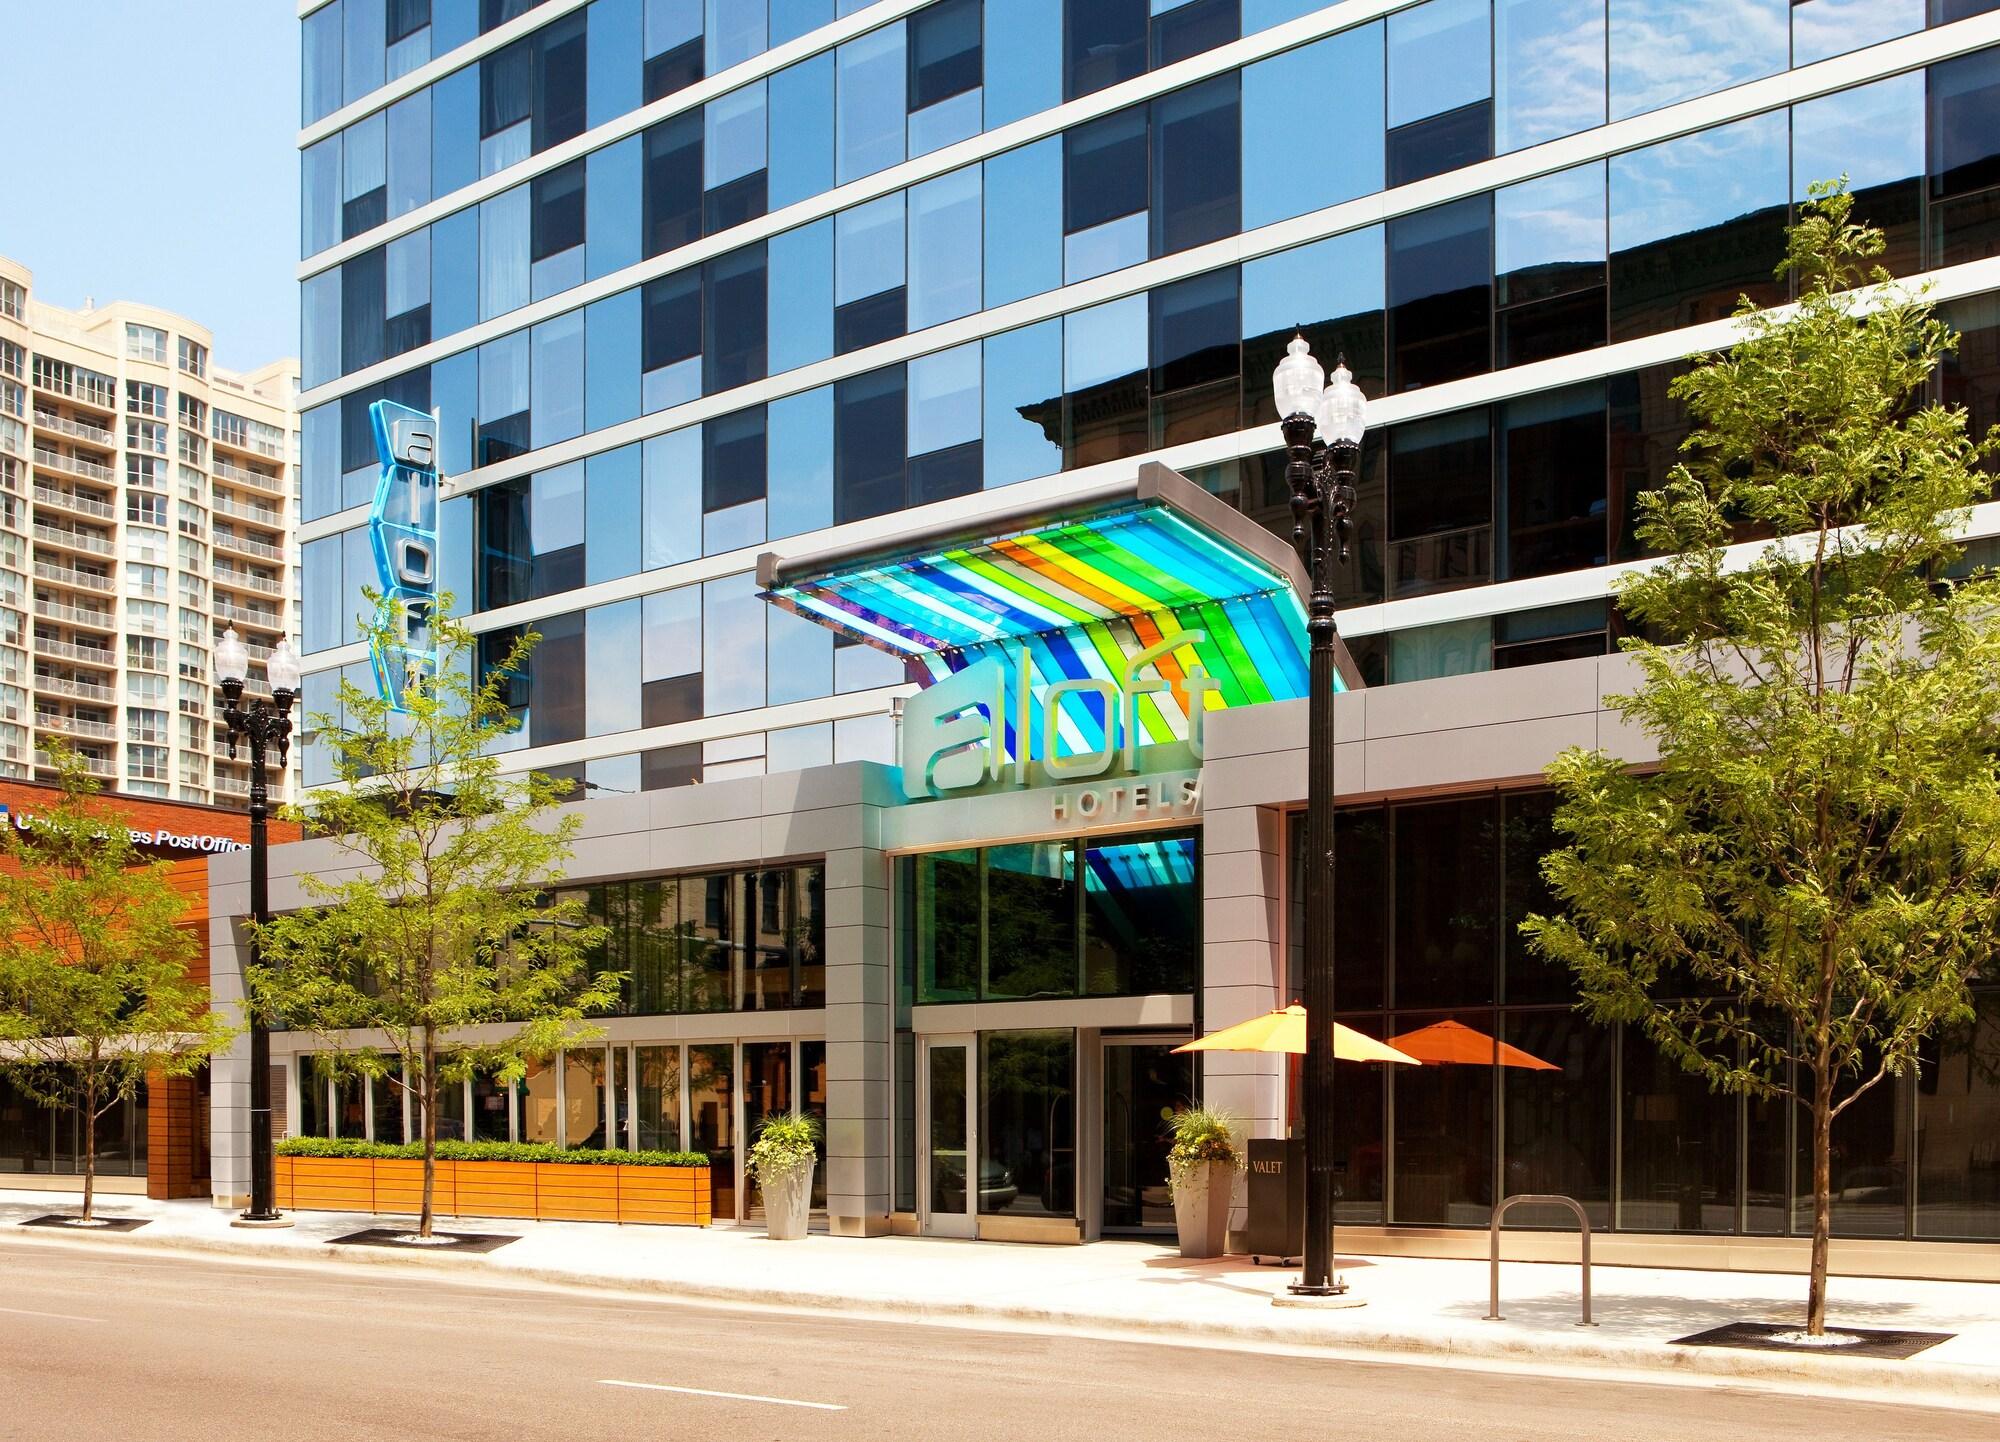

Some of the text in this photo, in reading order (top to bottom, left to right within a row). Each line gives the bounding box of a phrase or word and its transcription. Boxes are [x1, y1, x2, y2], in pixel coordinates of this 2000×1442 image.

[393, 419, 432, 705] aloft
[902, 629, 1221, 799] aloft
[1052, 778, 1199, 819] HOTELS
[155, 830, 198, 850] Post
[1253, 1160, 1283, 1174] VALET
